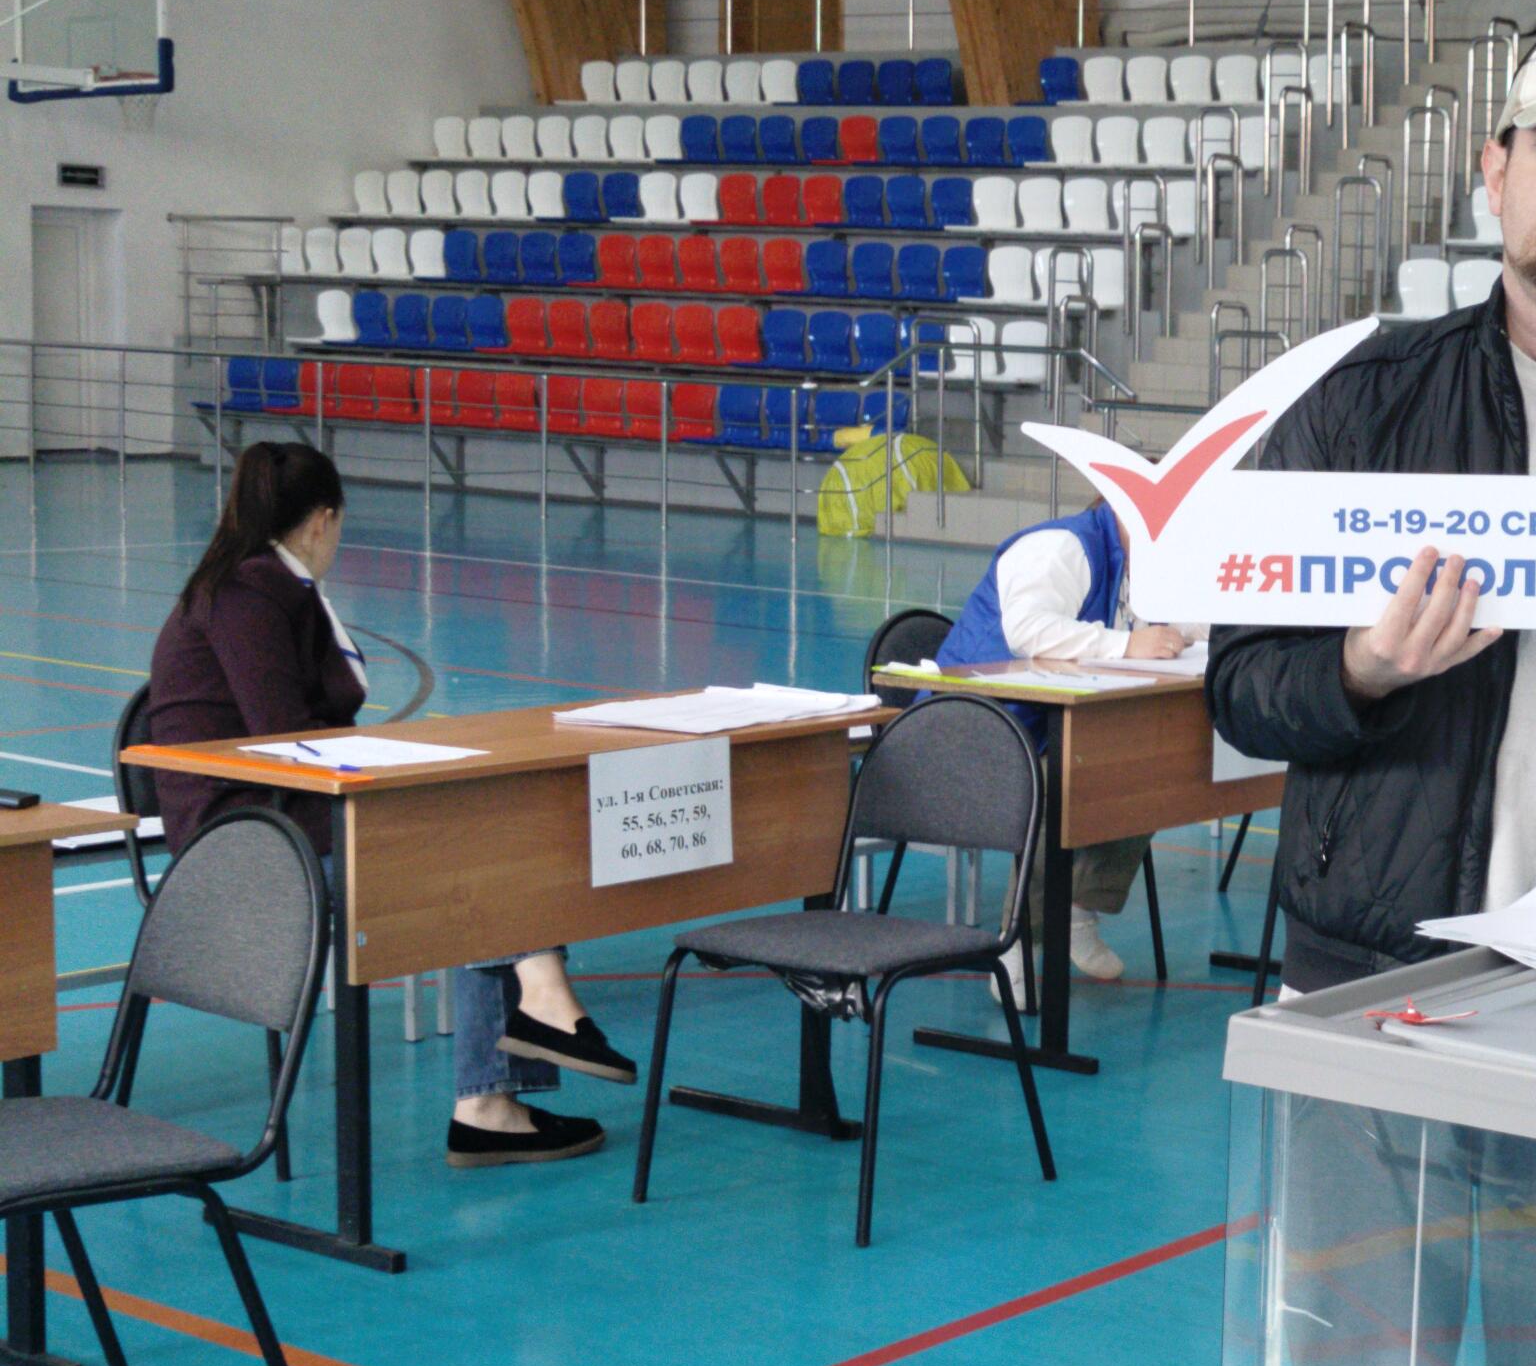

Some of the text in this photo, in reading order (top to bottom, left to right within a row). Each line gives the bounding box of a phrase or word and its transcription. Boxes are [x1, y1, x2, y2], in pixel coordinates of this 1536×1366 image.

[1333, 508, 1491, 536] 18-19-20
[596, 778, 725, 813] ул. 1-я Советская:
[621, 803, 711, 832] 55, 56, 57, 59,
[621, 831, 707, 859] 60, 68, 70, 86
